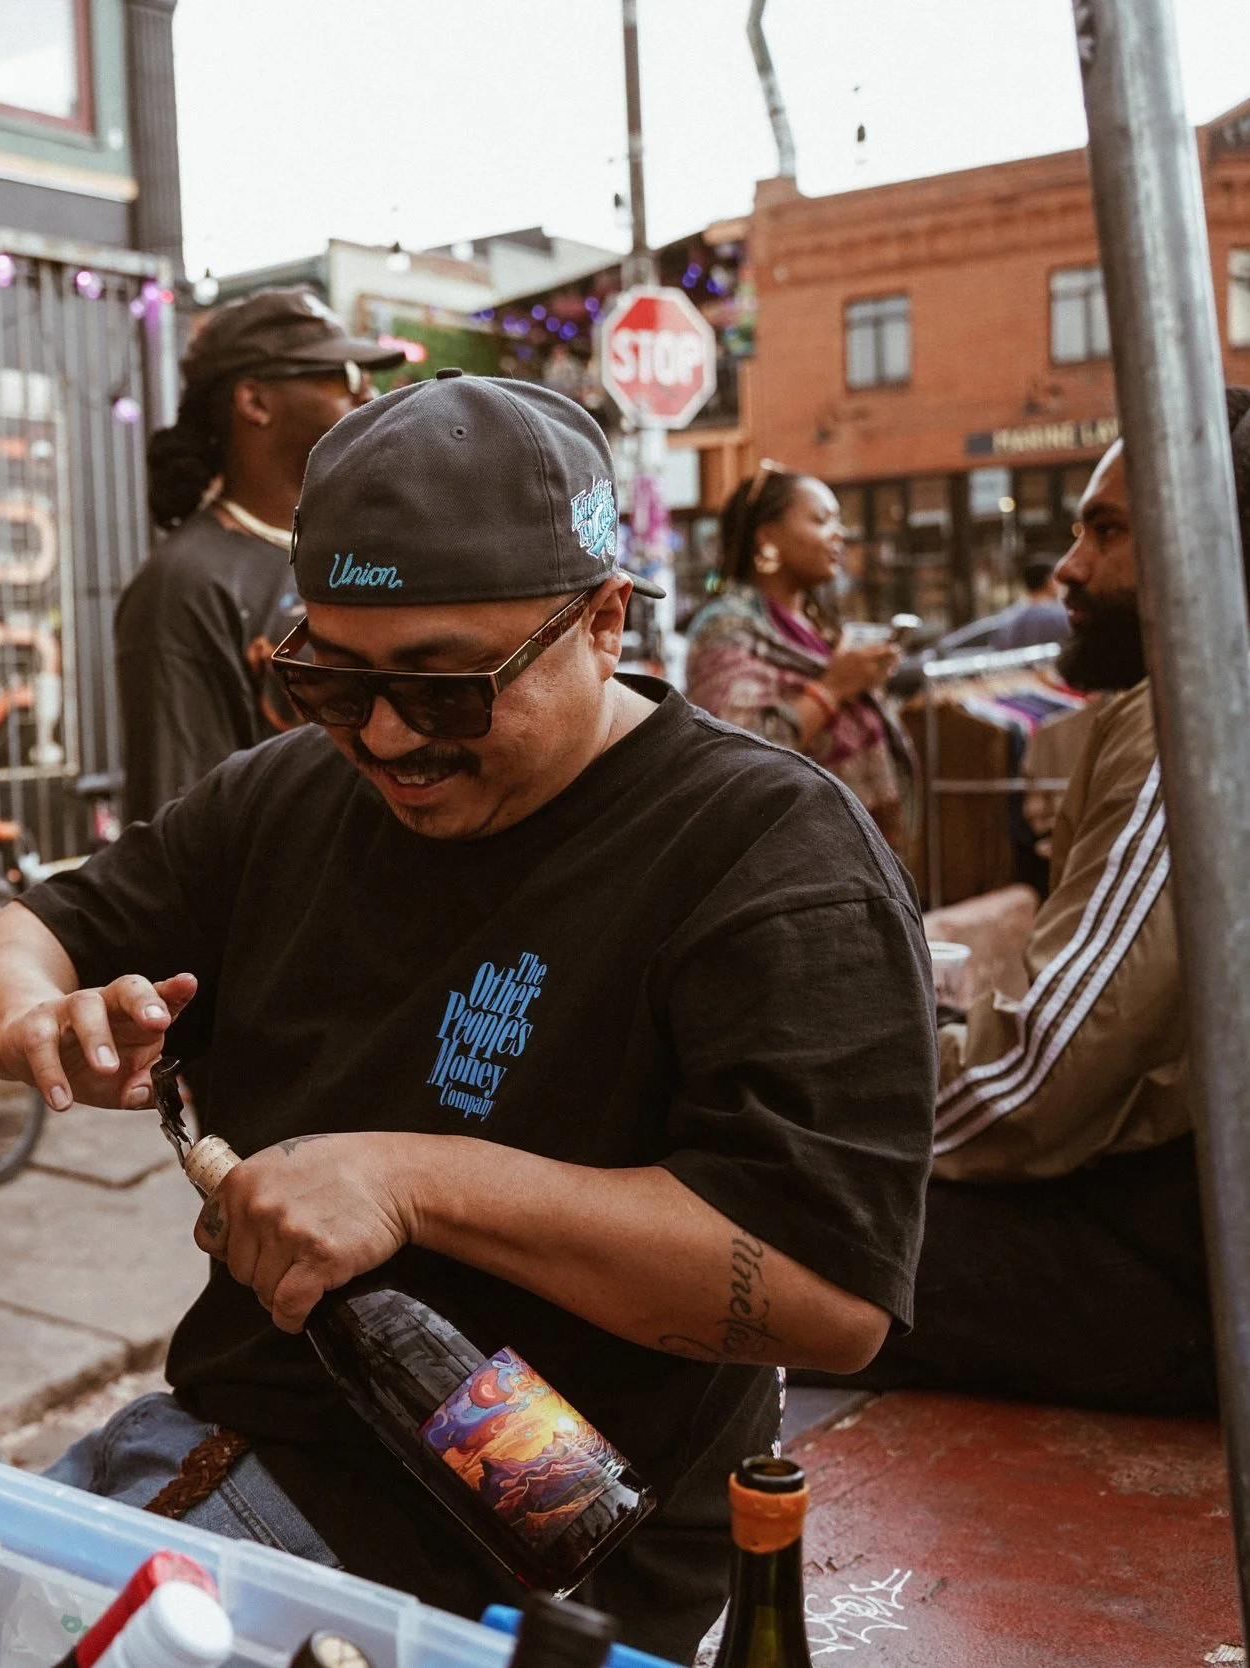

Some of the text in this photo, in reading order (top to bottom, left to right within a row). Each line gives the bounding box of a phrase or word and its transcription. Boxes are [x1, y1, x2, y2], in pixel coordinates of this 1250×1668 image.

[610, 328, 704, 386] STOP
[329, 552, 403, 589] Union
[469, 961, 541, 1019] Other
[515, 951, 547, 986] The
[436, 990, 534, 1059] People's
[426, 1038, 508, 1098] Money
[439, 1081, 497, 1123] Company
